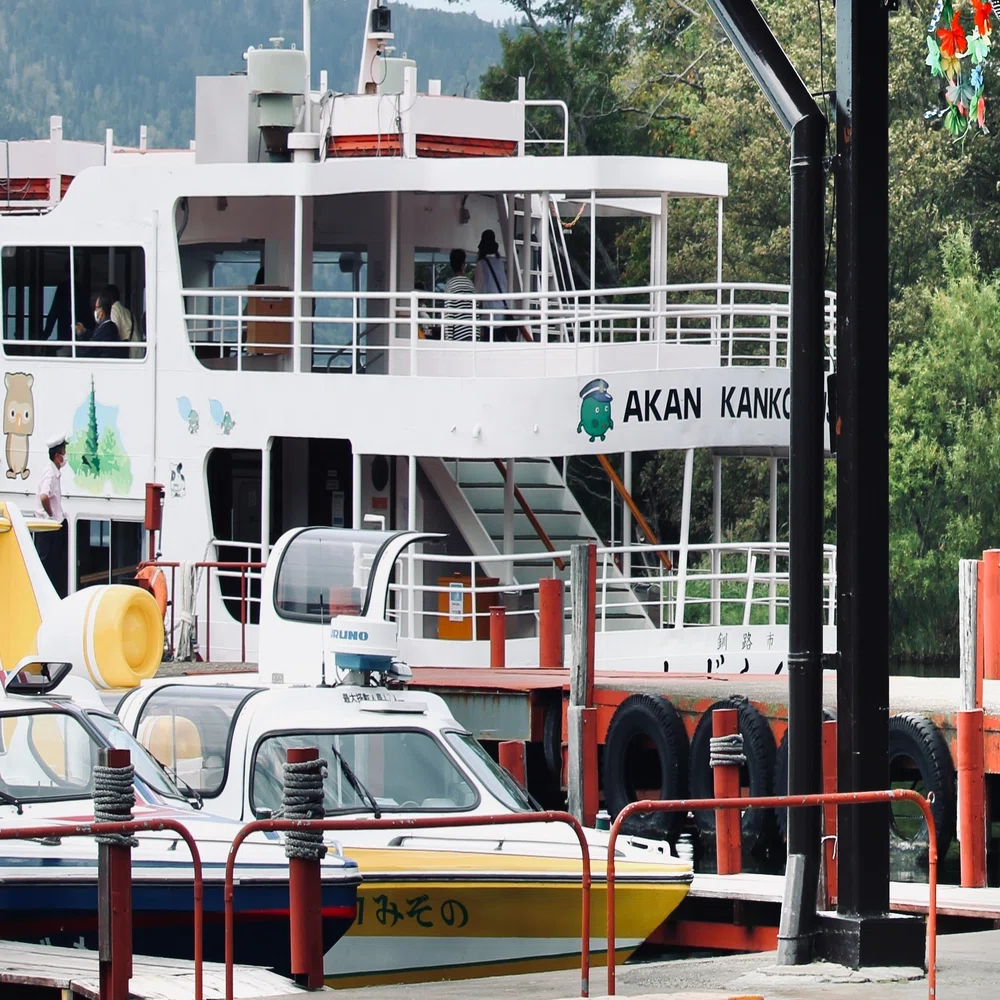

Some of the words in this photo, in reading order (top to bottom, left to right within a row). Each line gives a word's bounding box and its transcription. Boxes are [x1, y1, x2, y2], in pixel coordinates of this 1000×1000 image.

[623, 387, 701, 423] AKAN
[331, 629, 369, 641] RUNO
[717, 631, 775, 651] 釧路市
